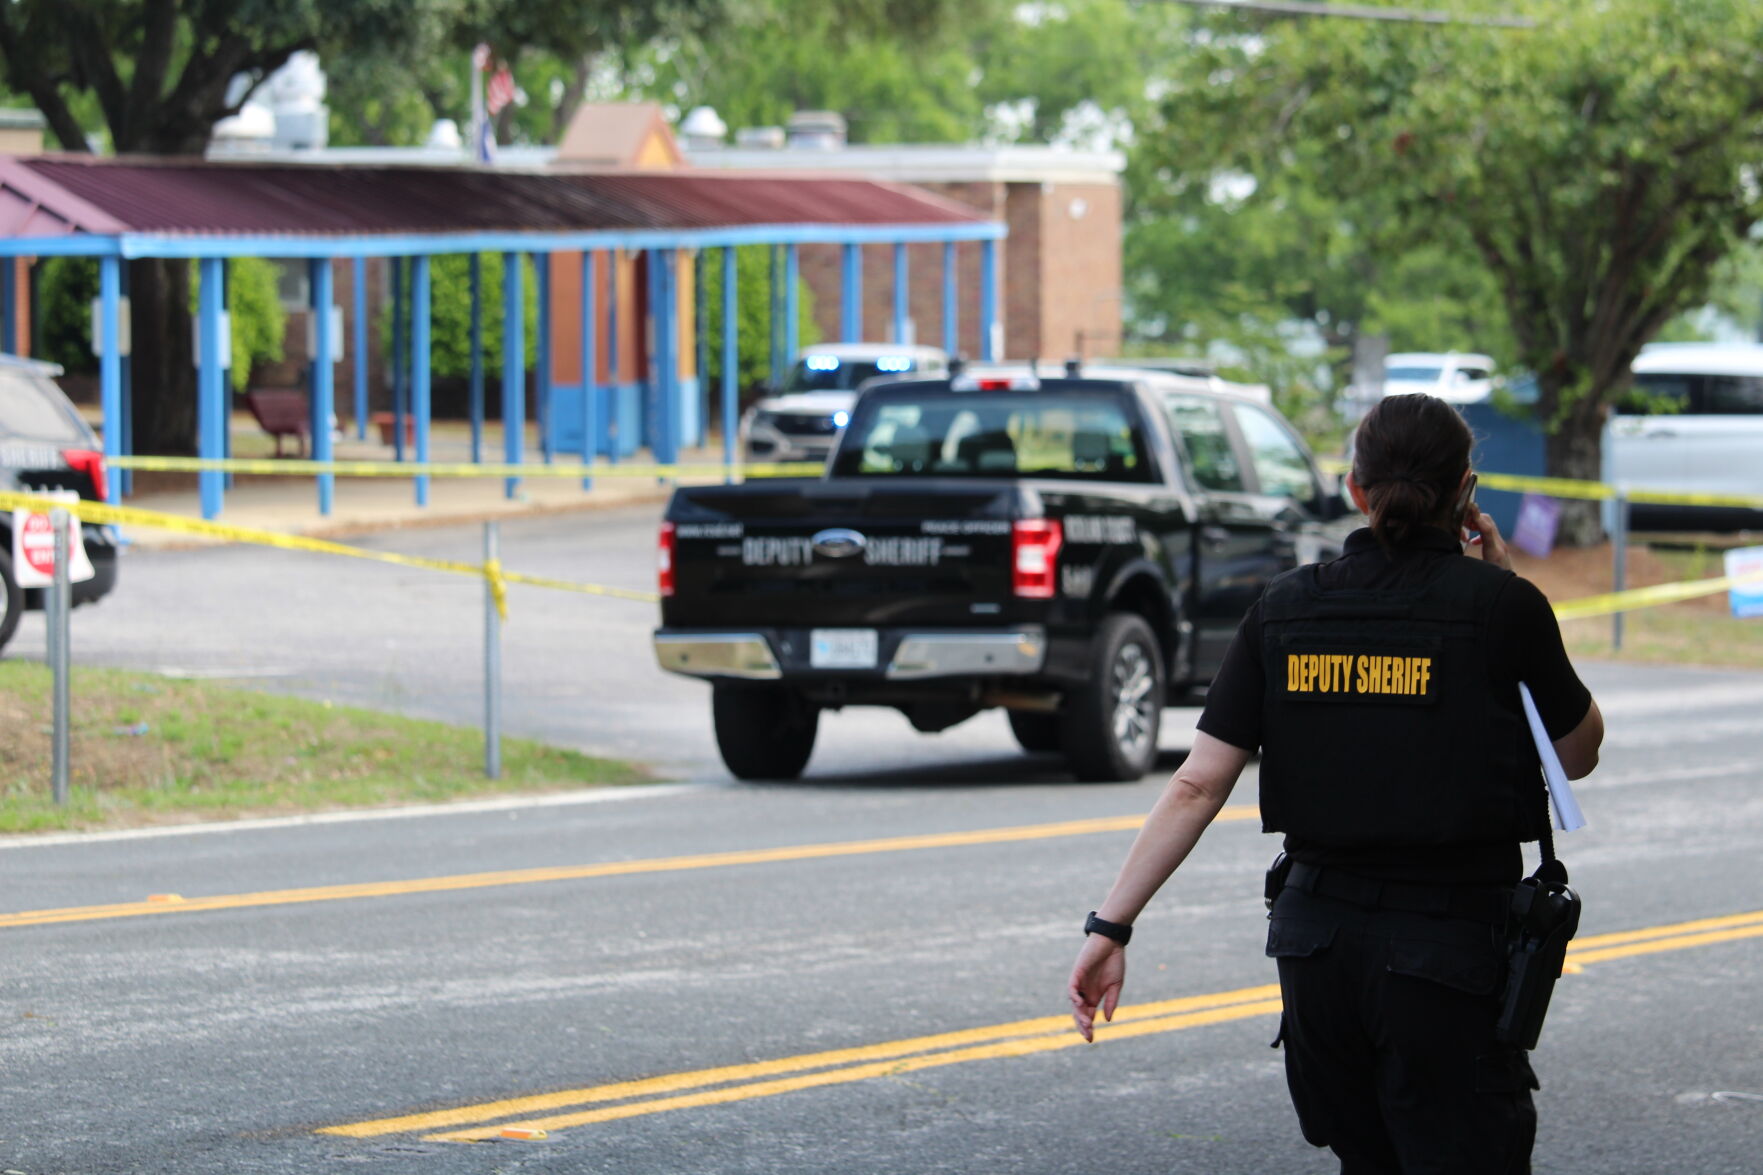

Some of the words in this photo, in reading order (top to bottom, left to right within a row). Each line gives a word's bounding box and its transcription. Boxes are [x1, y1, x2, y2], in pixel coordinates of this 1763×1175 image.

[742, 537, 812, 566] DEPUTY
[864, 537, 943, 566] SHERIFF
[1287, 654, 1354, 693] DEPUTY
[1356, 655, 1432, 695] SHERIFF
